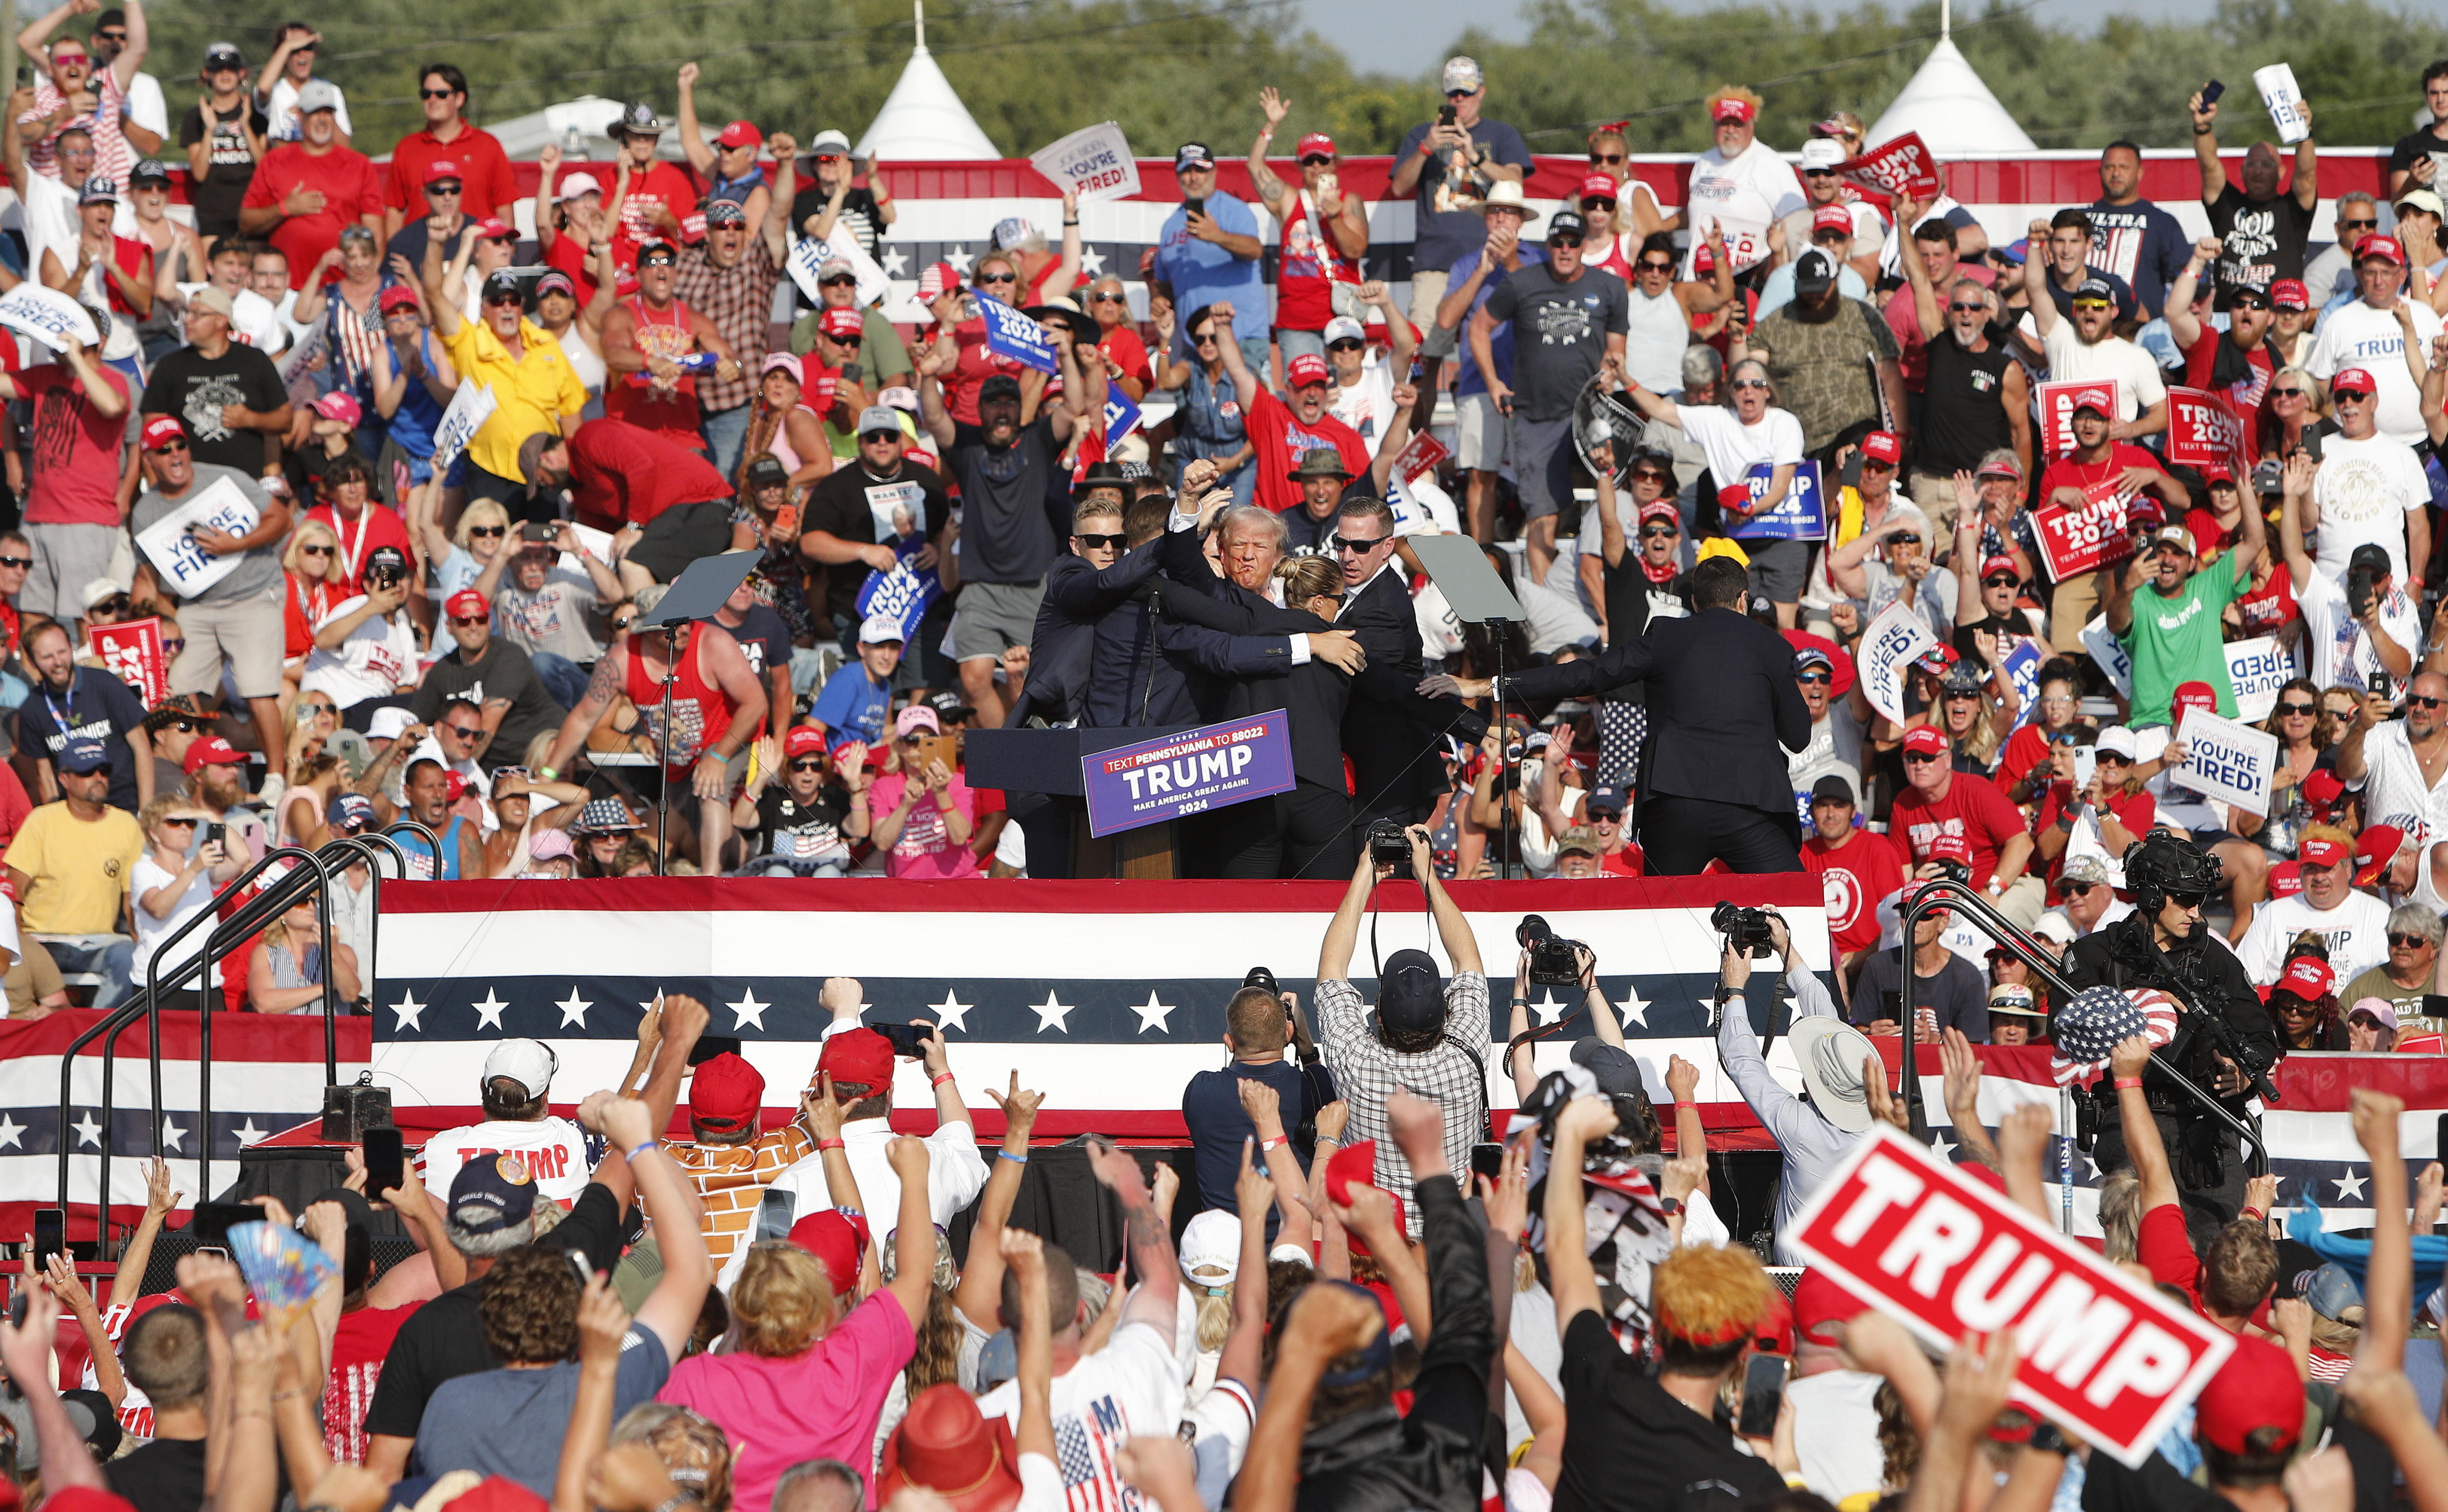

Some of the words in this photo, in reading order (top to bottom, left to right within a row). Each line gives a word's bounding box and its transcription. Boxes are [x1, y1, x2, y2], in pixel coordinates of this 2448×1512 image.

[1063, 150, 1118, 178] YOU'RE
[1847, 144, 1920, 178] TRUMP
[1077, 166, 1128, 195] FIRED!
[2234, 207, 2274, 239] GOD
[2232, 238, 2268, 256] GUNS
[2220, 259, 2277, 284] TRUMP
[18, 297, 77, 332] YOU'RE
[982, 298, 1042, 328] TRUM
[998, 316, 1042, 343] 2024
[2179, 442, 2200, 451] TEXT
[2202, 443, 2229, 453] TRUMP
[2048, 494, 2133, 537] TRUMP
[167, 506, 238, 557] YORE
[2066, 511, 2128, 550] 2024
[2059, 551, 2079, 564] TEXT
[2081, 542, 2109, 556] TRUMP
[866, 562, 914, 616] TRUM
[2245, 595, 2280, 615] TRUMP
[1796, 650, 1829, 661] TRUMP
[1871, 623, 1905, 691] YOU'RE
[2232, 651, 2296, 678] FIRED
[1881, 629, 1921, 710] FIRED!
[2181, 695, 2194, 703] MAKE
[2195, 695, 2213, 703] AMERICA
[1107, 758, 1133, 772] TEXT
[1135, 740, 1214, 767] PENNSYLVANIA
[1215, 733, 1230, 745] TO
[1231, 727, 1264, 742] 88022
[2191, 736, 2259, 772] YOU'RE
[2193, 725, 2241, 751] CROOKED
[2240, 741, 2260, 757] JOE
[1122, 744, 1253, 800] TRUMP
[2181, 753, 2261, 796] FIRED!
[1133, 800, 1156, 813] MAKE
[1157, 793, 1193, 808] AMERICA
[1194, 786, 1219, 800] GREAT
[1222, 778, 1249, 791] AGAIN!
[1177, 799, 1209, 816] 2024
[1936, 837, 1964, 846] TRUMP
[2066, 857, 2091, 867] TRUMP
[1956, 933, 1974, 946] PA
[2286, 931, 2352, 951] TMP
[2291, 970, 2319, 984] TRUMP
[2294, 962, 2323, 977] MARYLAND
[1445, 1036, 1468, 1051] SONY
[1503, 1045, 1514, 1070] Canon
[458, 1191, 483, 1204] DONALD
[484, 1192, 507, 1207] TRUMP
[1831, 1152, 2191, 1409] TRUMP
